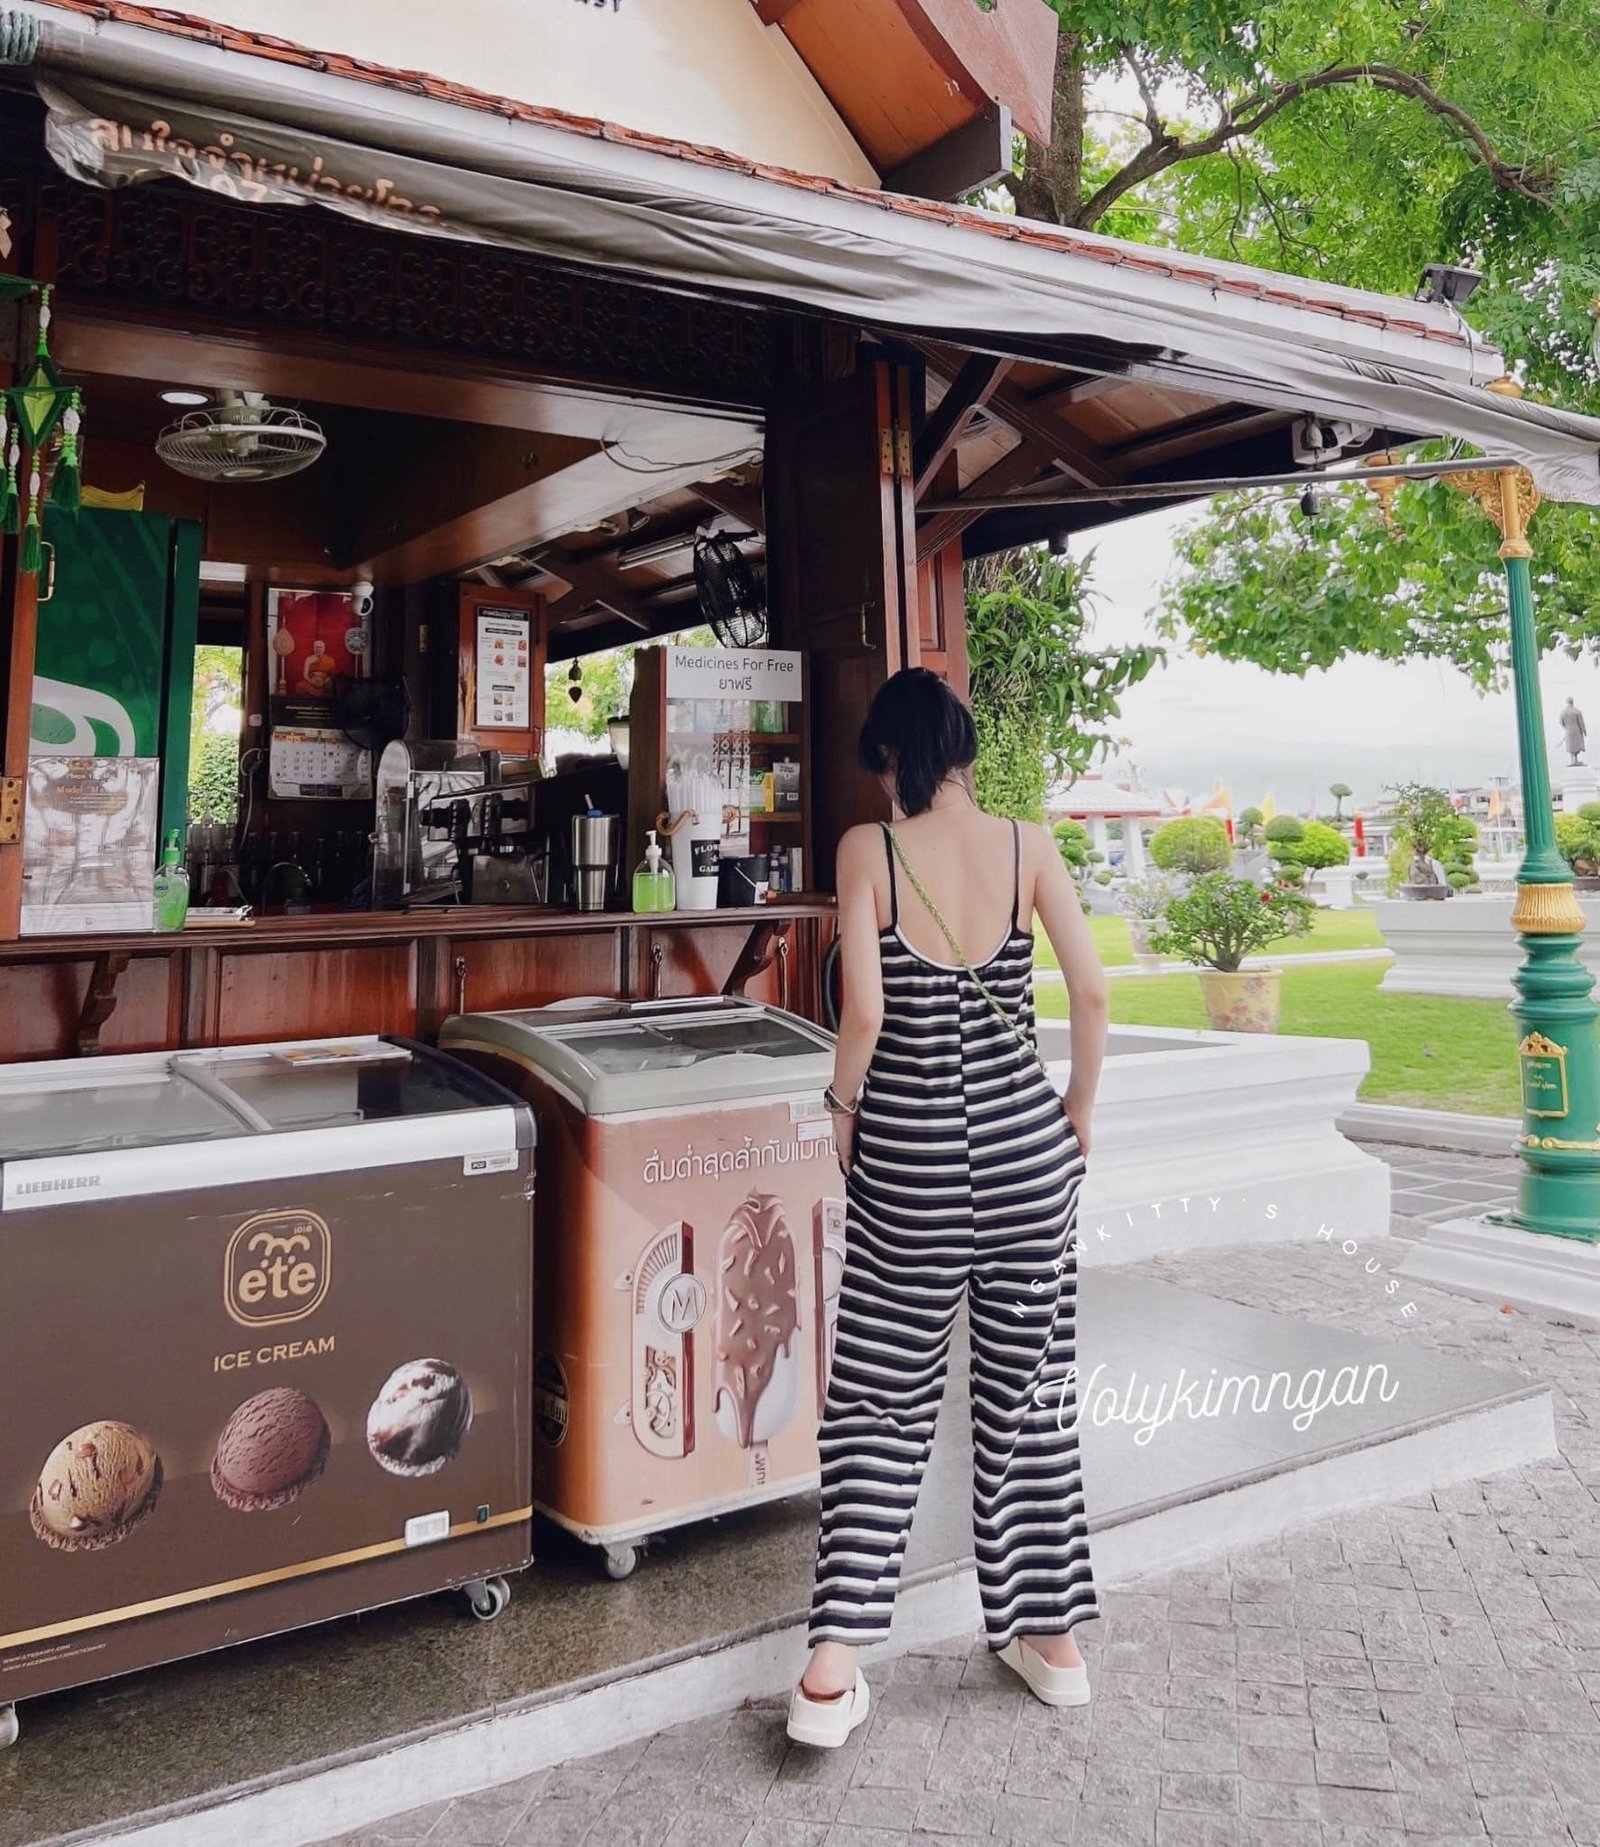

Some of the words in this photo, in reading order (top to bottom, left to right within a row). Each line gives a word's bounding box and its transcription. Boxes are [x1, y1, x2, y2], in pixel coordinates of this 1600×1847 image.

[674, 655, 739, 670] Medicines
[743, 657, 763, 671] For
[767, 658, 794, 672] Free
[719, 676, 752, 690] ยาฟรี
[16, 1175, 101, 1195] LIEBHERR
[213, 1350, 252, 1373] ICE
[256, 1335, 335, 1364] CREAM
